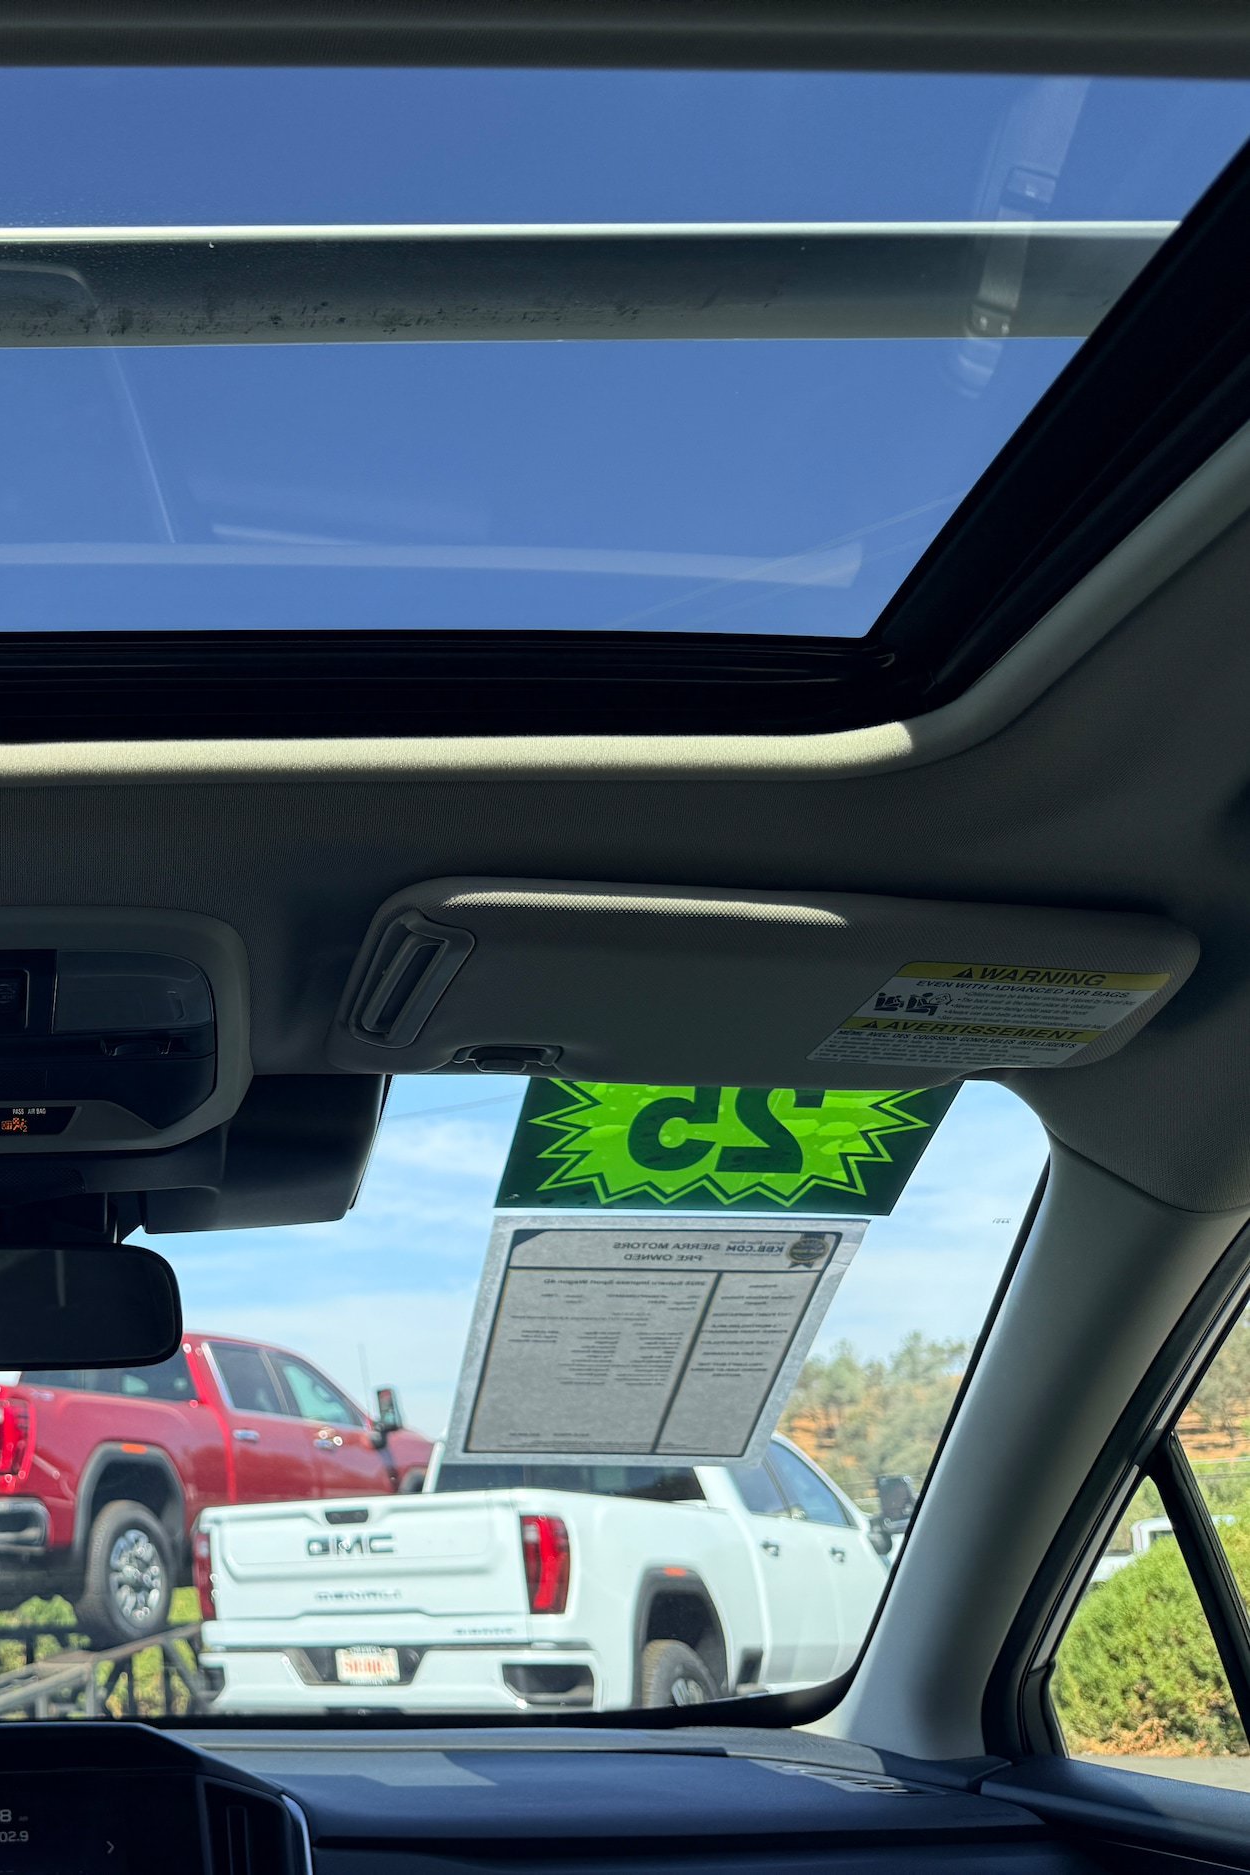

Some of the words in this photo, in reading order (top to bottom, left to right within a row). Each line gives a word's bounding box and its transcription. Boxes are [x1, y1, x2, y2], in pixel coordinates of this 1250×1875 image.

[980, 967, 1106, 986] WARNING
[916, 980, 952, 988] EVEN
[955, 982, 990, 990] WITH
[993, 984, 1064, 994] ADVANCED
[881, 1021, 1083, 1039] AVERTISSEMENT
[307, 1534, 395, 1556] GMC
